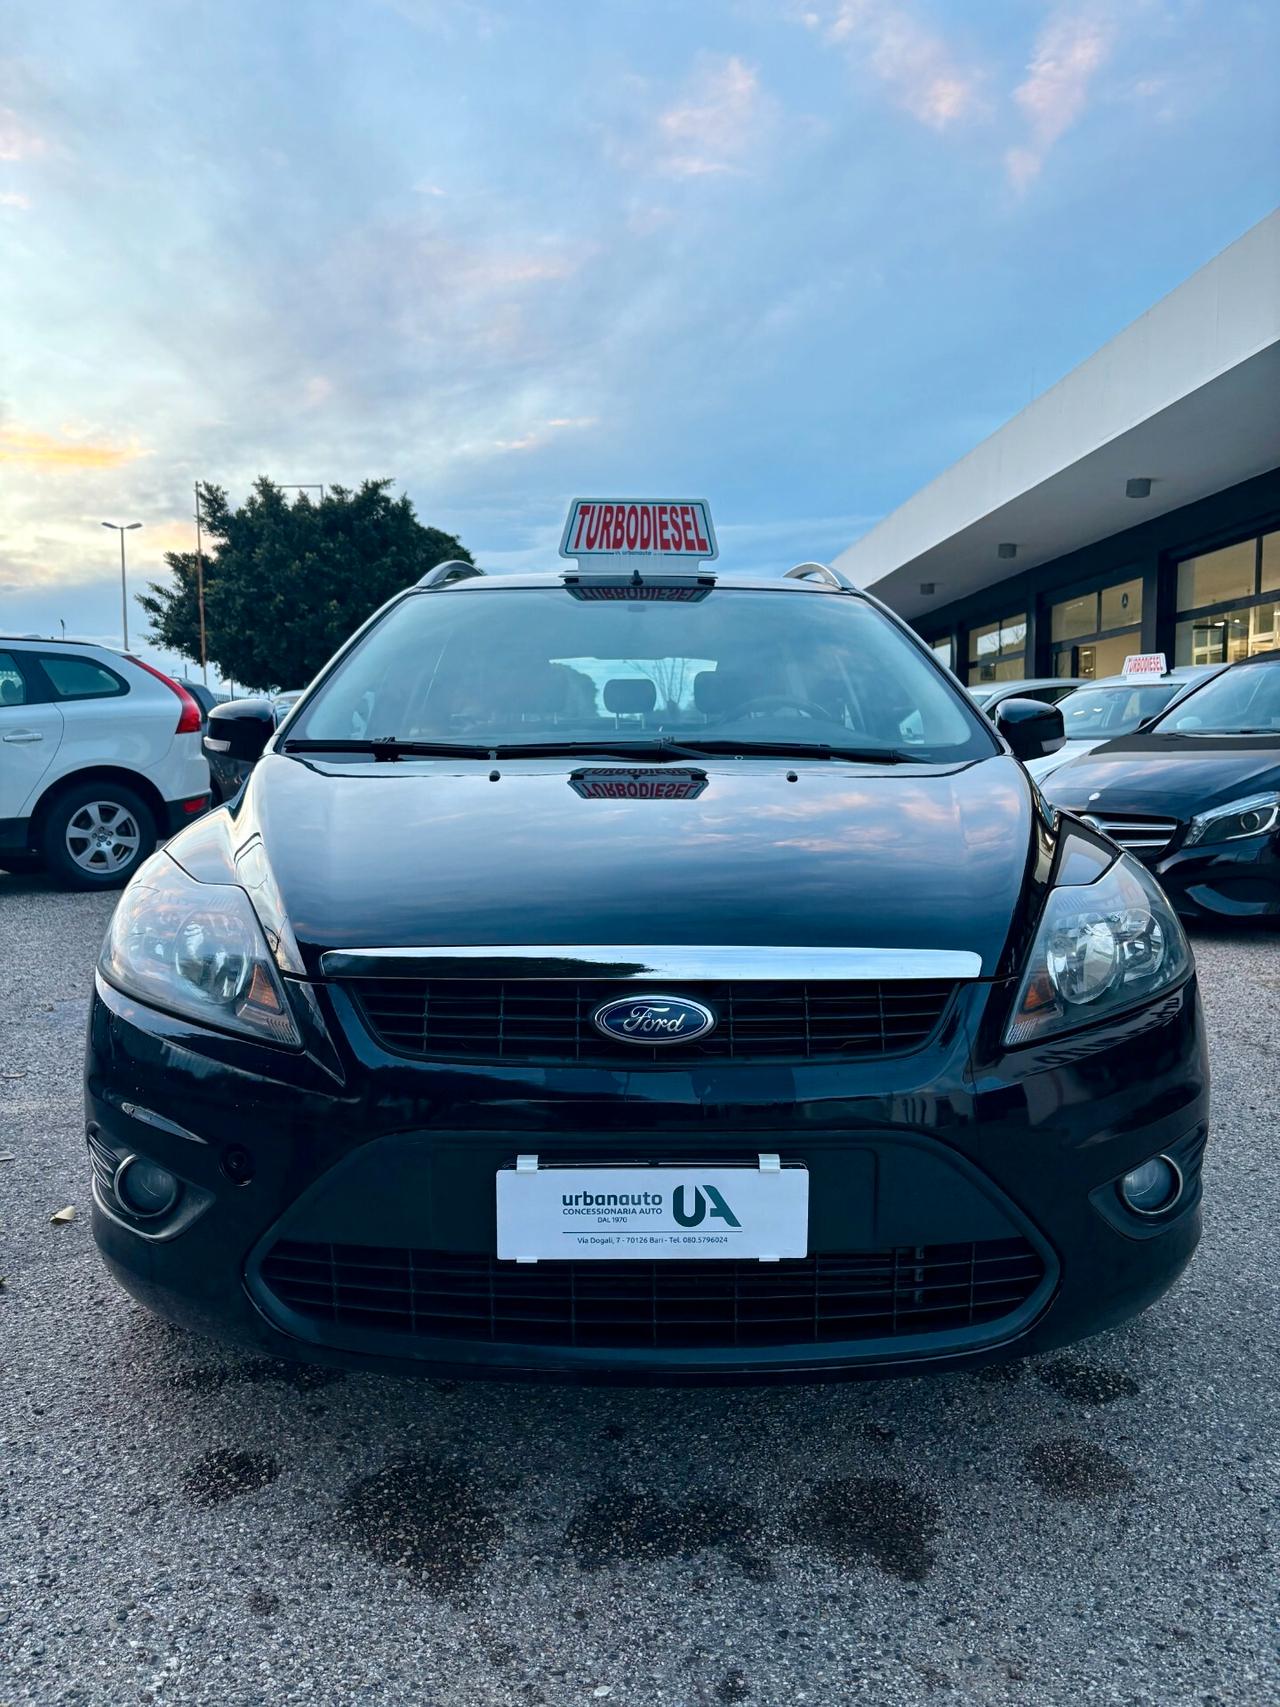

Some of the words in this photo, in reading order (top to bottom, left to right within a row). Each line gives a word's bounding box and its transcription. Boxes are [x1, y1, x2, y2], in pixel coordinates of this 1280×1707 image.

[575, 505, 708, 551] TURBODIESEL
[623, 1005, 686, 1032] Ford
[562, 1190, 662, 1206] urbanauto
[672, 1184, 742, 1228] UA
[562, 1208, 637, 1216] CONCESSIONARIA
[639, 1208, 663, 1216] AUTO
[597, 1216, 610, 1224] DAL
[612, 1216, 628, 1224] 1970
[577, 1236, 589, 1244] Via
[590, 1236, 615, 1246] Dogali,
[616, 1236, 621, 1244] 7
[626, 1236, 648, 1244] 70126
[649, 1236, 664, 1244] Bari
[669, 1236, 681, 1244] Tel.
[682, 1236, 728, 1244] 080.5796024
